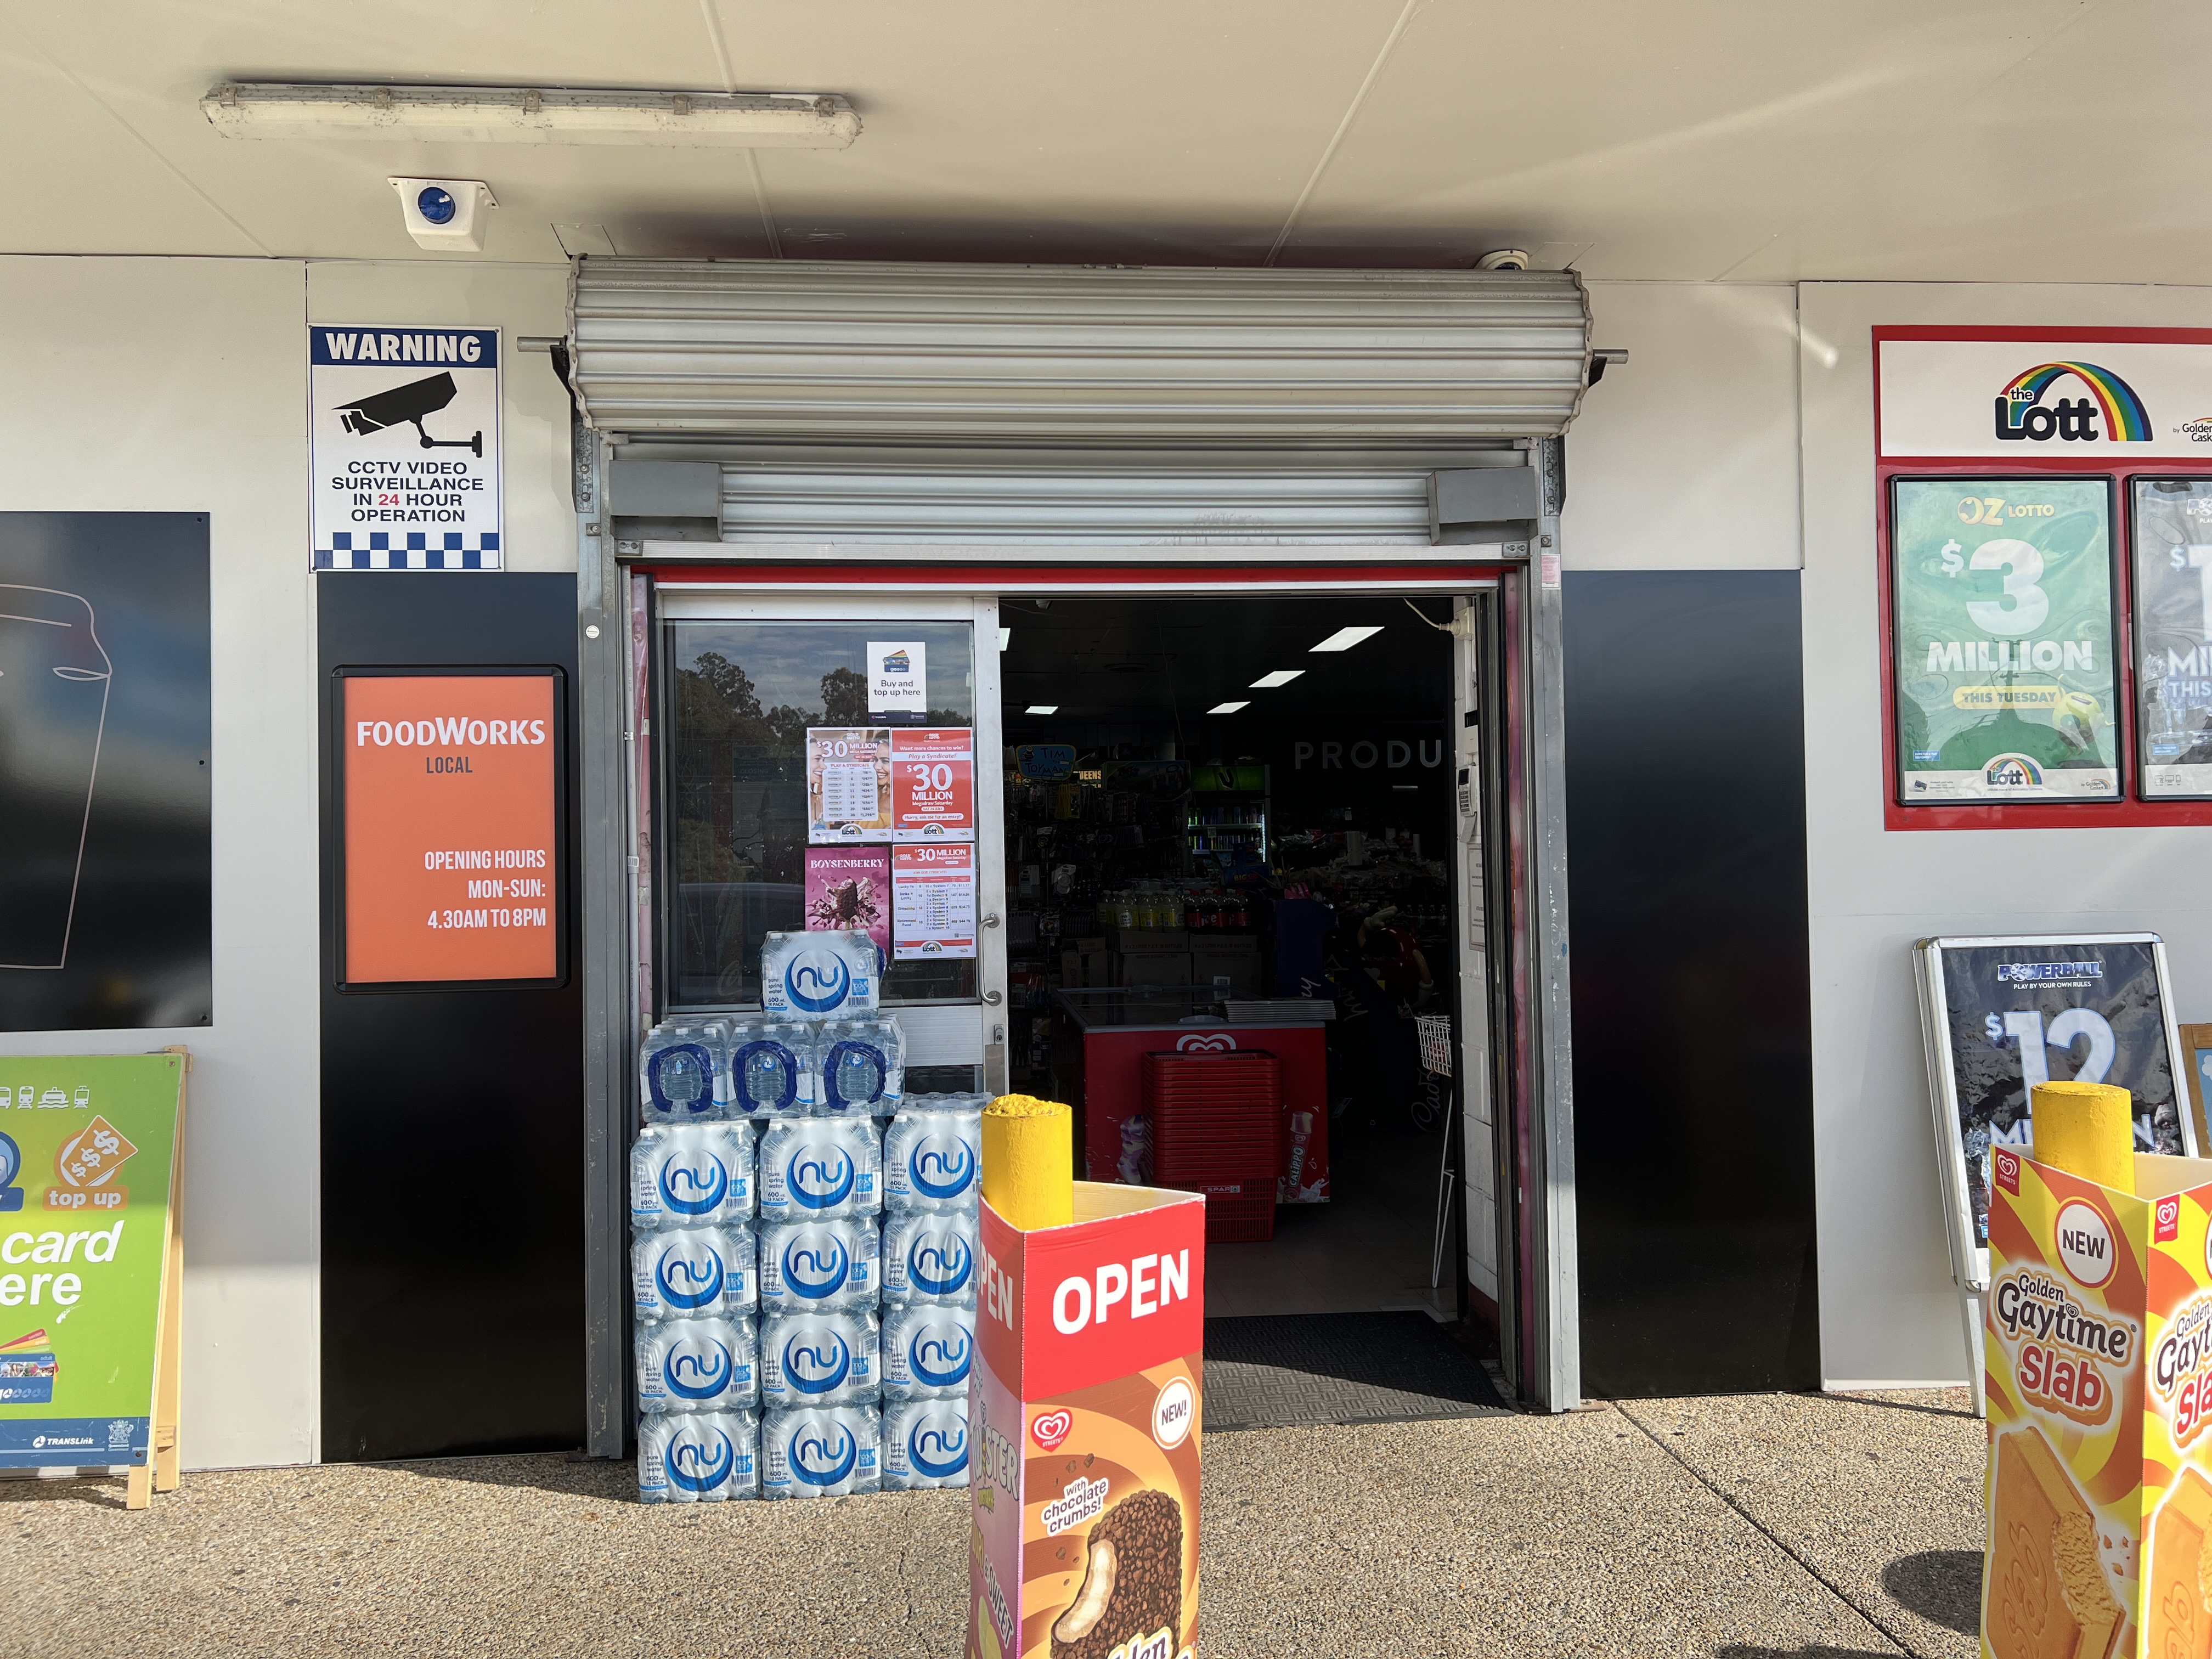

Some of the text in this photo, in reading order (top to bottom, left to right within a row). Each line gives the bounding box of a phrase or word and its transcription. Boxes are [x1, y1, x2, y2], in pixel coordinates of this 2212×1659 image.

[325, 333, 482, 362] WARNING
[2011, 388, 2033, 400] the
[1995, 397, 2098, 441] Lott
[348, 461, 467, 475] CCTV VIDEO
[332, 477, 483, 490] SURVEILLANCE
[353, 494, 462, 506] IN 24 HOUR
[1957, 496, 2055, 526] OZ LOTTO
[351, 509, 465, 522] OPERATION
[1941, 538, 2049, 636] $3
[1926, 640, 2092, 672] MILLION
[881, 680, 896, 688] Buy
[1962, 692, 2056, 703] THIS TUESDAY
[357, 717, 545, 746] FOODWORKS
[816, 741, 848, 758] $30
[1041, 747, 1065, 759] TIM
[426, 757, 473, 774] LOCAL
[906, 763, 953, 791] $30
[1987, 770, 2023, 785] Lott
[912, 791, 953, 800] MILLION
[424, 849, 546, 870] OPENING HOURS
[811, 859, 884, 868] BOYSENBERRY
[914, 848, 935, 861] $30
[467, 878, 546, 899] MON-SUN:
[427, 908, 546, 929] 4.30AM TO 8PM
[797, 966, 838, 989] nu
[1997, 962, 2103, 981] POWERBALL
[799, 1160, 843, 1184] nu
[921, 1152, 963, 1174] nu
[1290, 1146, 1305, 1187] CALIPPO
[672, 1167, 715, 1191] nu
[1999, 1173, 2016, 1186] STREETS
[49, 1190, 121, 1209] top up
[2159, 1223, 2175, 1233] STREETS
[2, 1220, 125, 1264] card
[2063, 1229, 2105, 1260] NEW
[794, 1249, 836, 1273] nu
[919, 1248, 961, 1271] nu
[668, 1260, 711, 1283] nu
[1053, 1249, 1189, 1335] OPEN
[2019, 1274, 2064, 1302] Golden
[1998, 1282, 2127, 1359] Gaytime
[2177, 1302, 2210, 1337] Golden
[794, 1346, 837, 1370] nu
[921, 1338, 964, 1363] nu
[676, 1353, 719, 1377] nu
[2021, 1345, 2101, 1408] Slab
[1161, 1400, 1187, 1426] NEW!
[801, 1437, 844, 1462] nu
[920, 1429, 963, 1454] nu
[1042, 1437, 1061, 1447] STREETS
[678, 1443, 721, 1466] nu
[1066, 1480, 1086, 1497] with
[1043, 1482, 1107, 1521] chocolate
[1049, 1497, 1102, 1534] crumbs!
[989, 1562, 1013, 1649] SWEET
